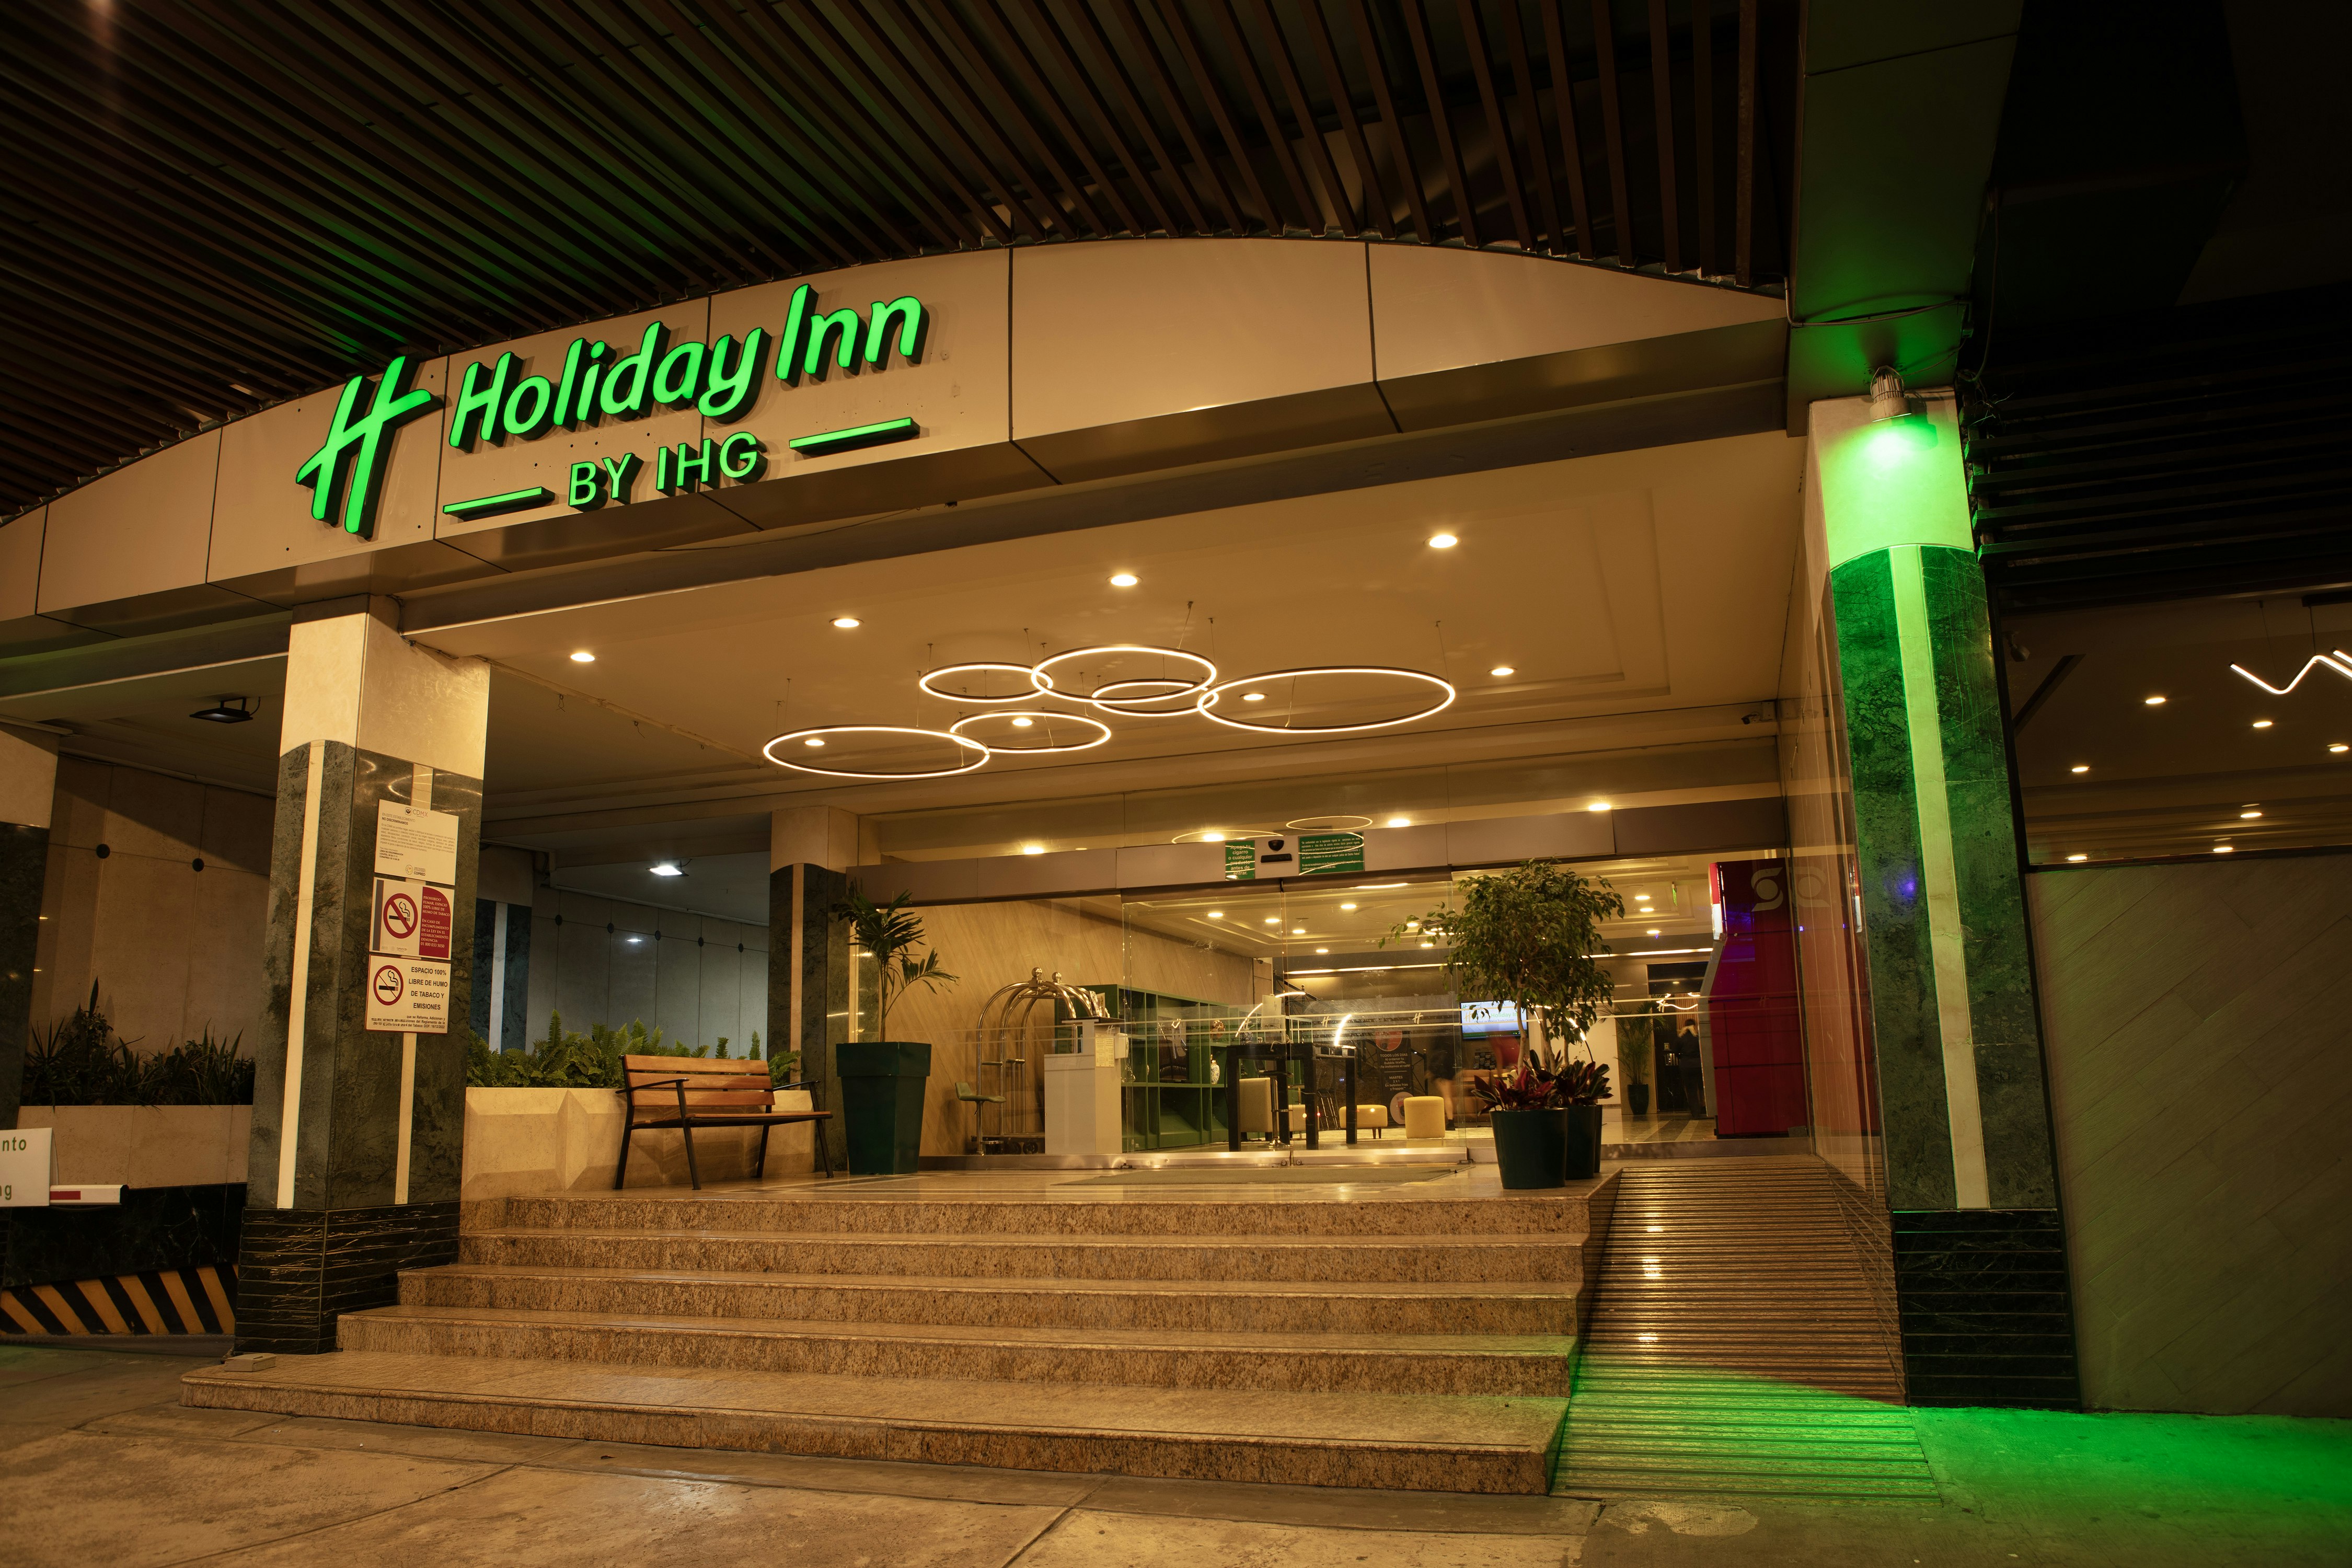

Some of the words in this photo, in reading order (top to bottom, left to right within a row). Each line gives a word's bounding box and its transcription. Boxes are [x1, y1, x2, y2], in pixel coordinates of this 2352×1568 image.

[449, 321, 767, 448] Holiday
[775, 283, 923, 380] Inn
[568, 453, 634, 507] BY
[657, 432, 760, 492] IHG
